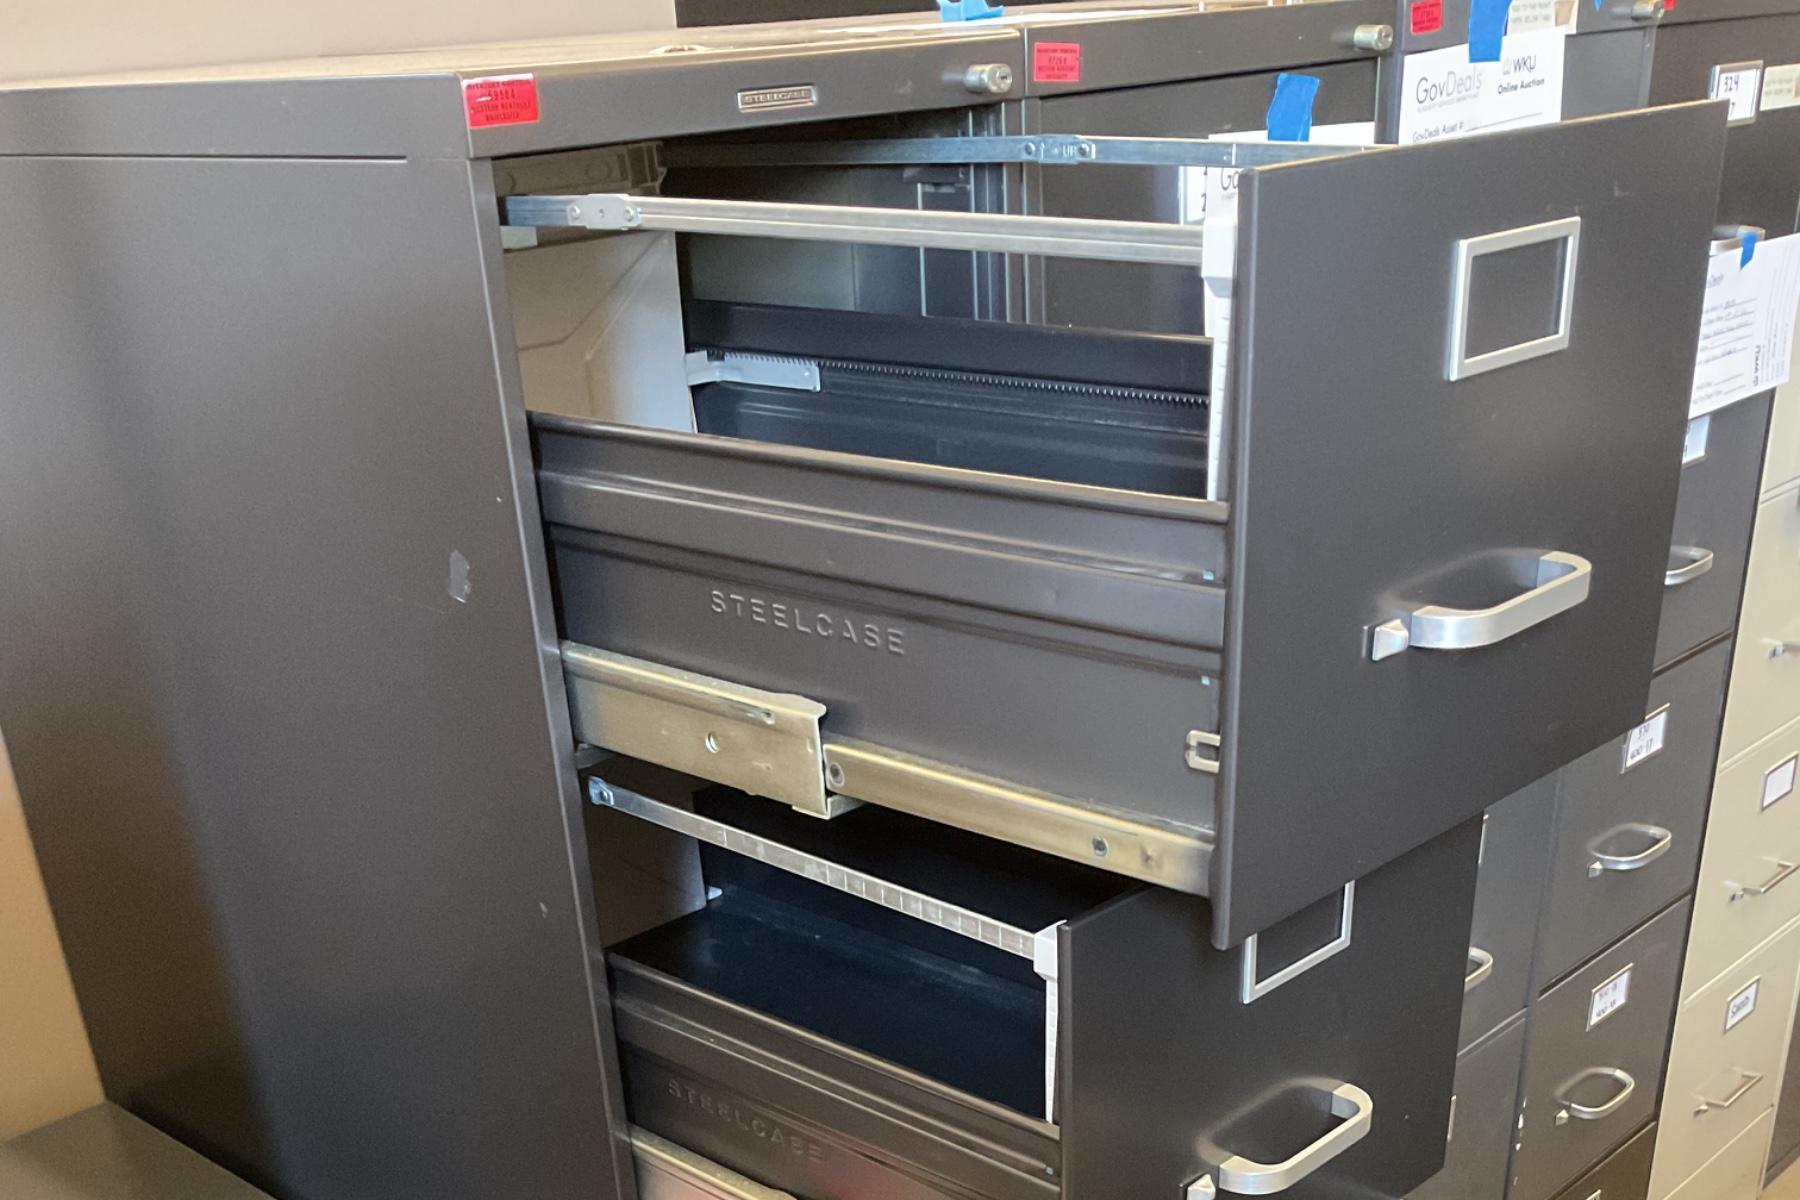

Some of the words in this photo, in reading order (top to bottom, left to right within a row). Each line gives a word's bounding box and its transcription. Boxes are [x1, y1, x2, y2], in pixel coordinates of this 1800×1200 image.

[1513, 55, 1537, 73] WKU
[744, 88, 811, 104] STEELCASE
[1416, 66, 1482, 104] GovDeals
[1497, 83, 1518, 95] Online
[1520, 77, 1545, 90] Auction
[711, 590, 905, 654] STEELCASE
[668, 1079, 824, 1165] STEELCASE
